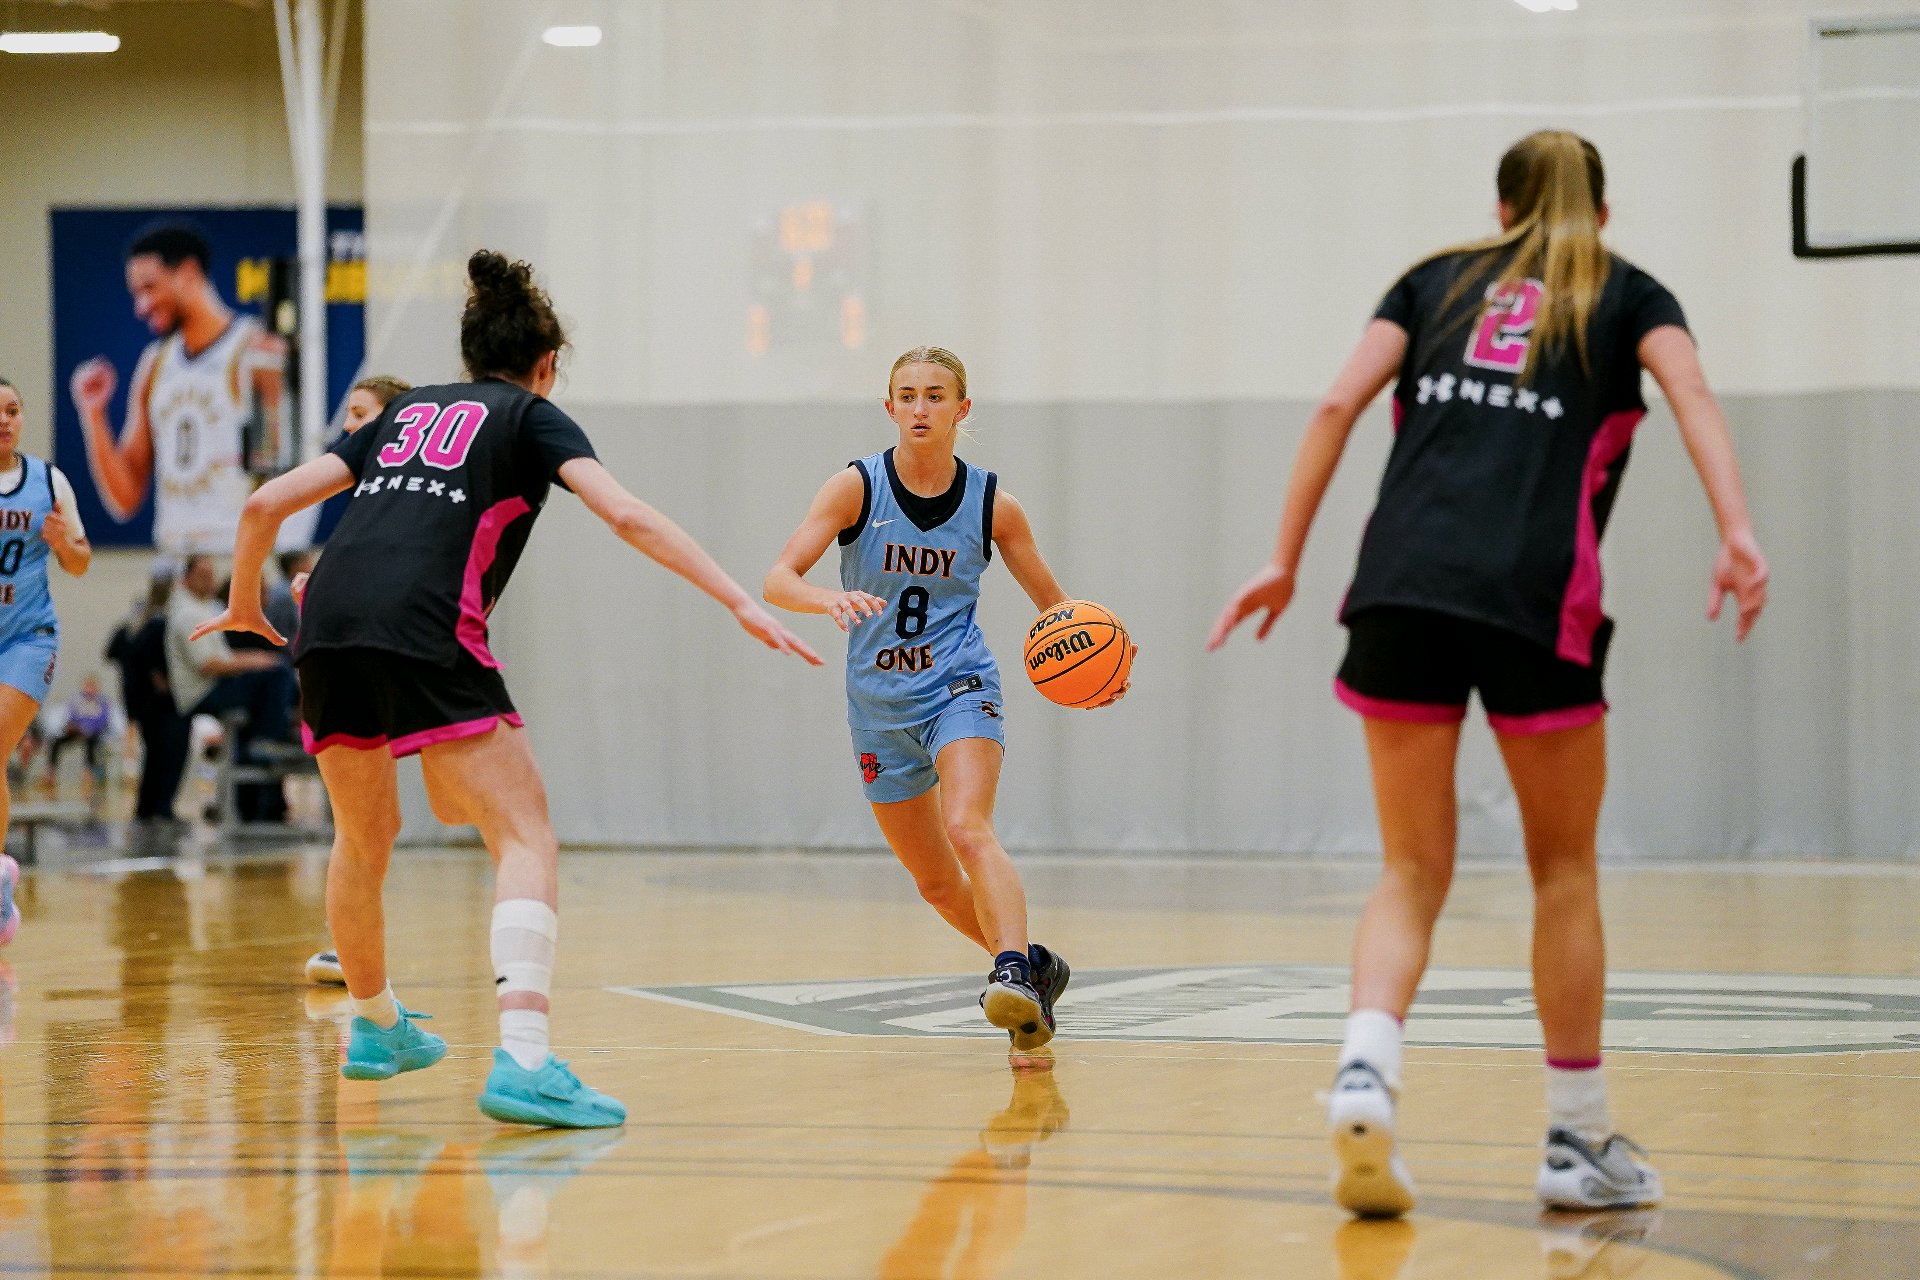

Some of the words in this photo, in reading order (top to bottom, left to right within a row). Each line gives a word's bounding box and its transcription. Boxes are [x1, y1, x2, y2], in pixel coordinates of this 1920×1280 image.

[1463, 277, 1546, 374] 2
[377, 400, 489, 471] 30
[0, 509, 33, 533] DY
[882, 542, 958, 578] INDY
[895, 585, 930, 640] 8
[1028, 608, 1075, 642] NCAA
[875, 643, 934, 673] ONE
[1028, 630, 1096, 671] Wilson
